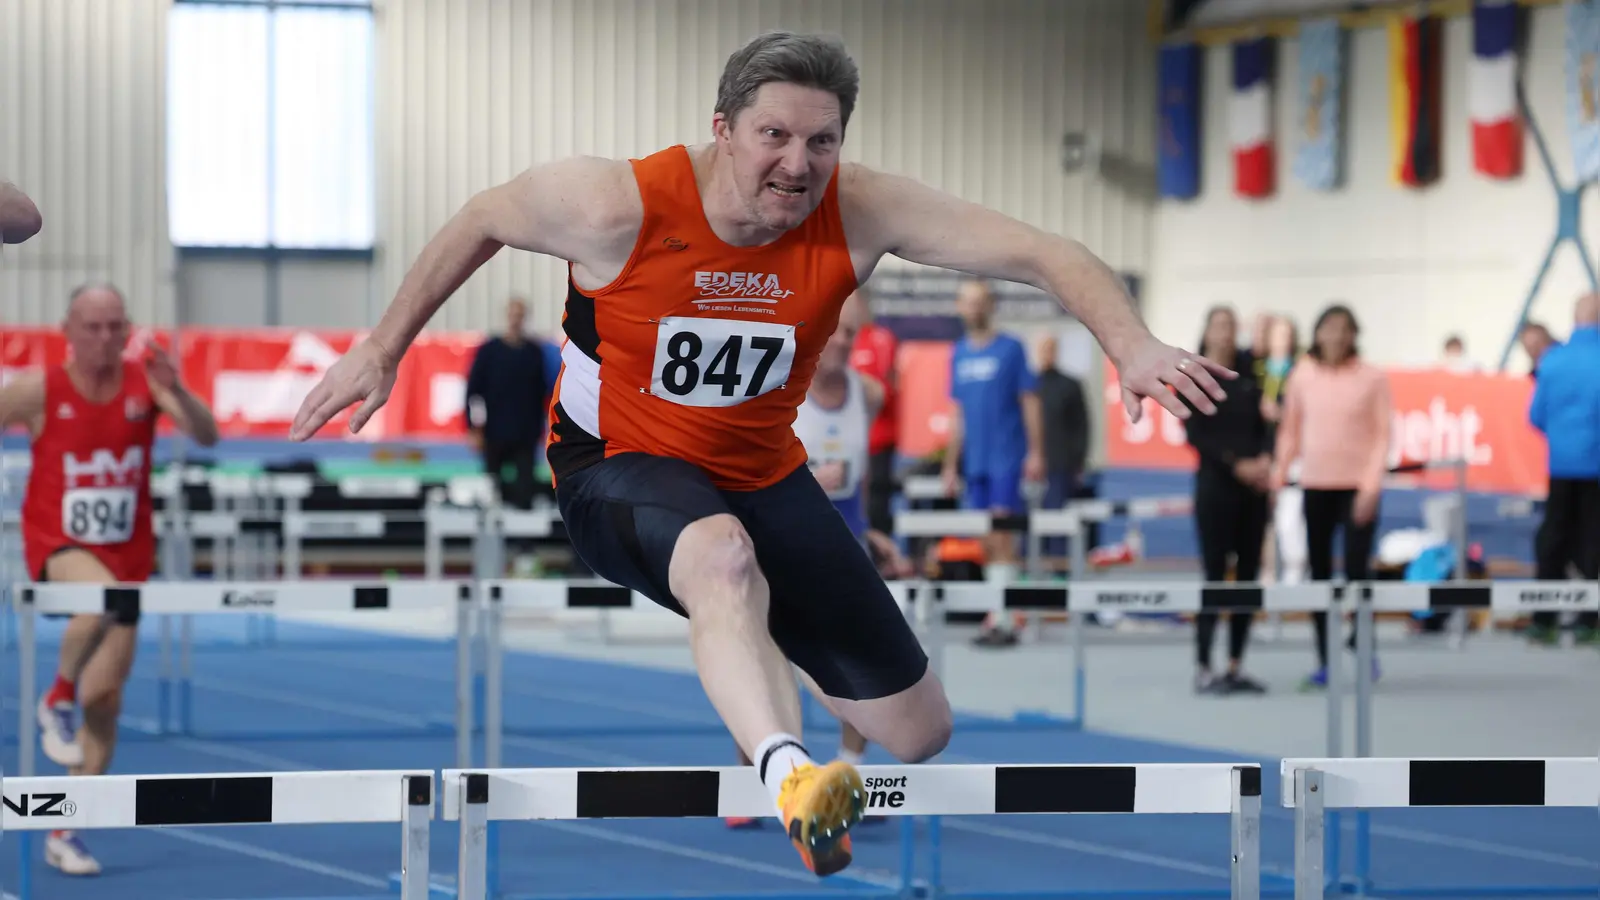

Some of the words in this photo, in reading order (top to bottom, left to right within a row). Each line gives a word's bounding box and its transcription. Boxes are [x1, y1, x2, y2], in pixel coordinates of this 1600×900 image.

[694, 271, 780, 291] EDEKA
[661, 331, 785, 397] 847
[70, 499, 129, 536] 894
[865, 776, 908, 790] sport
